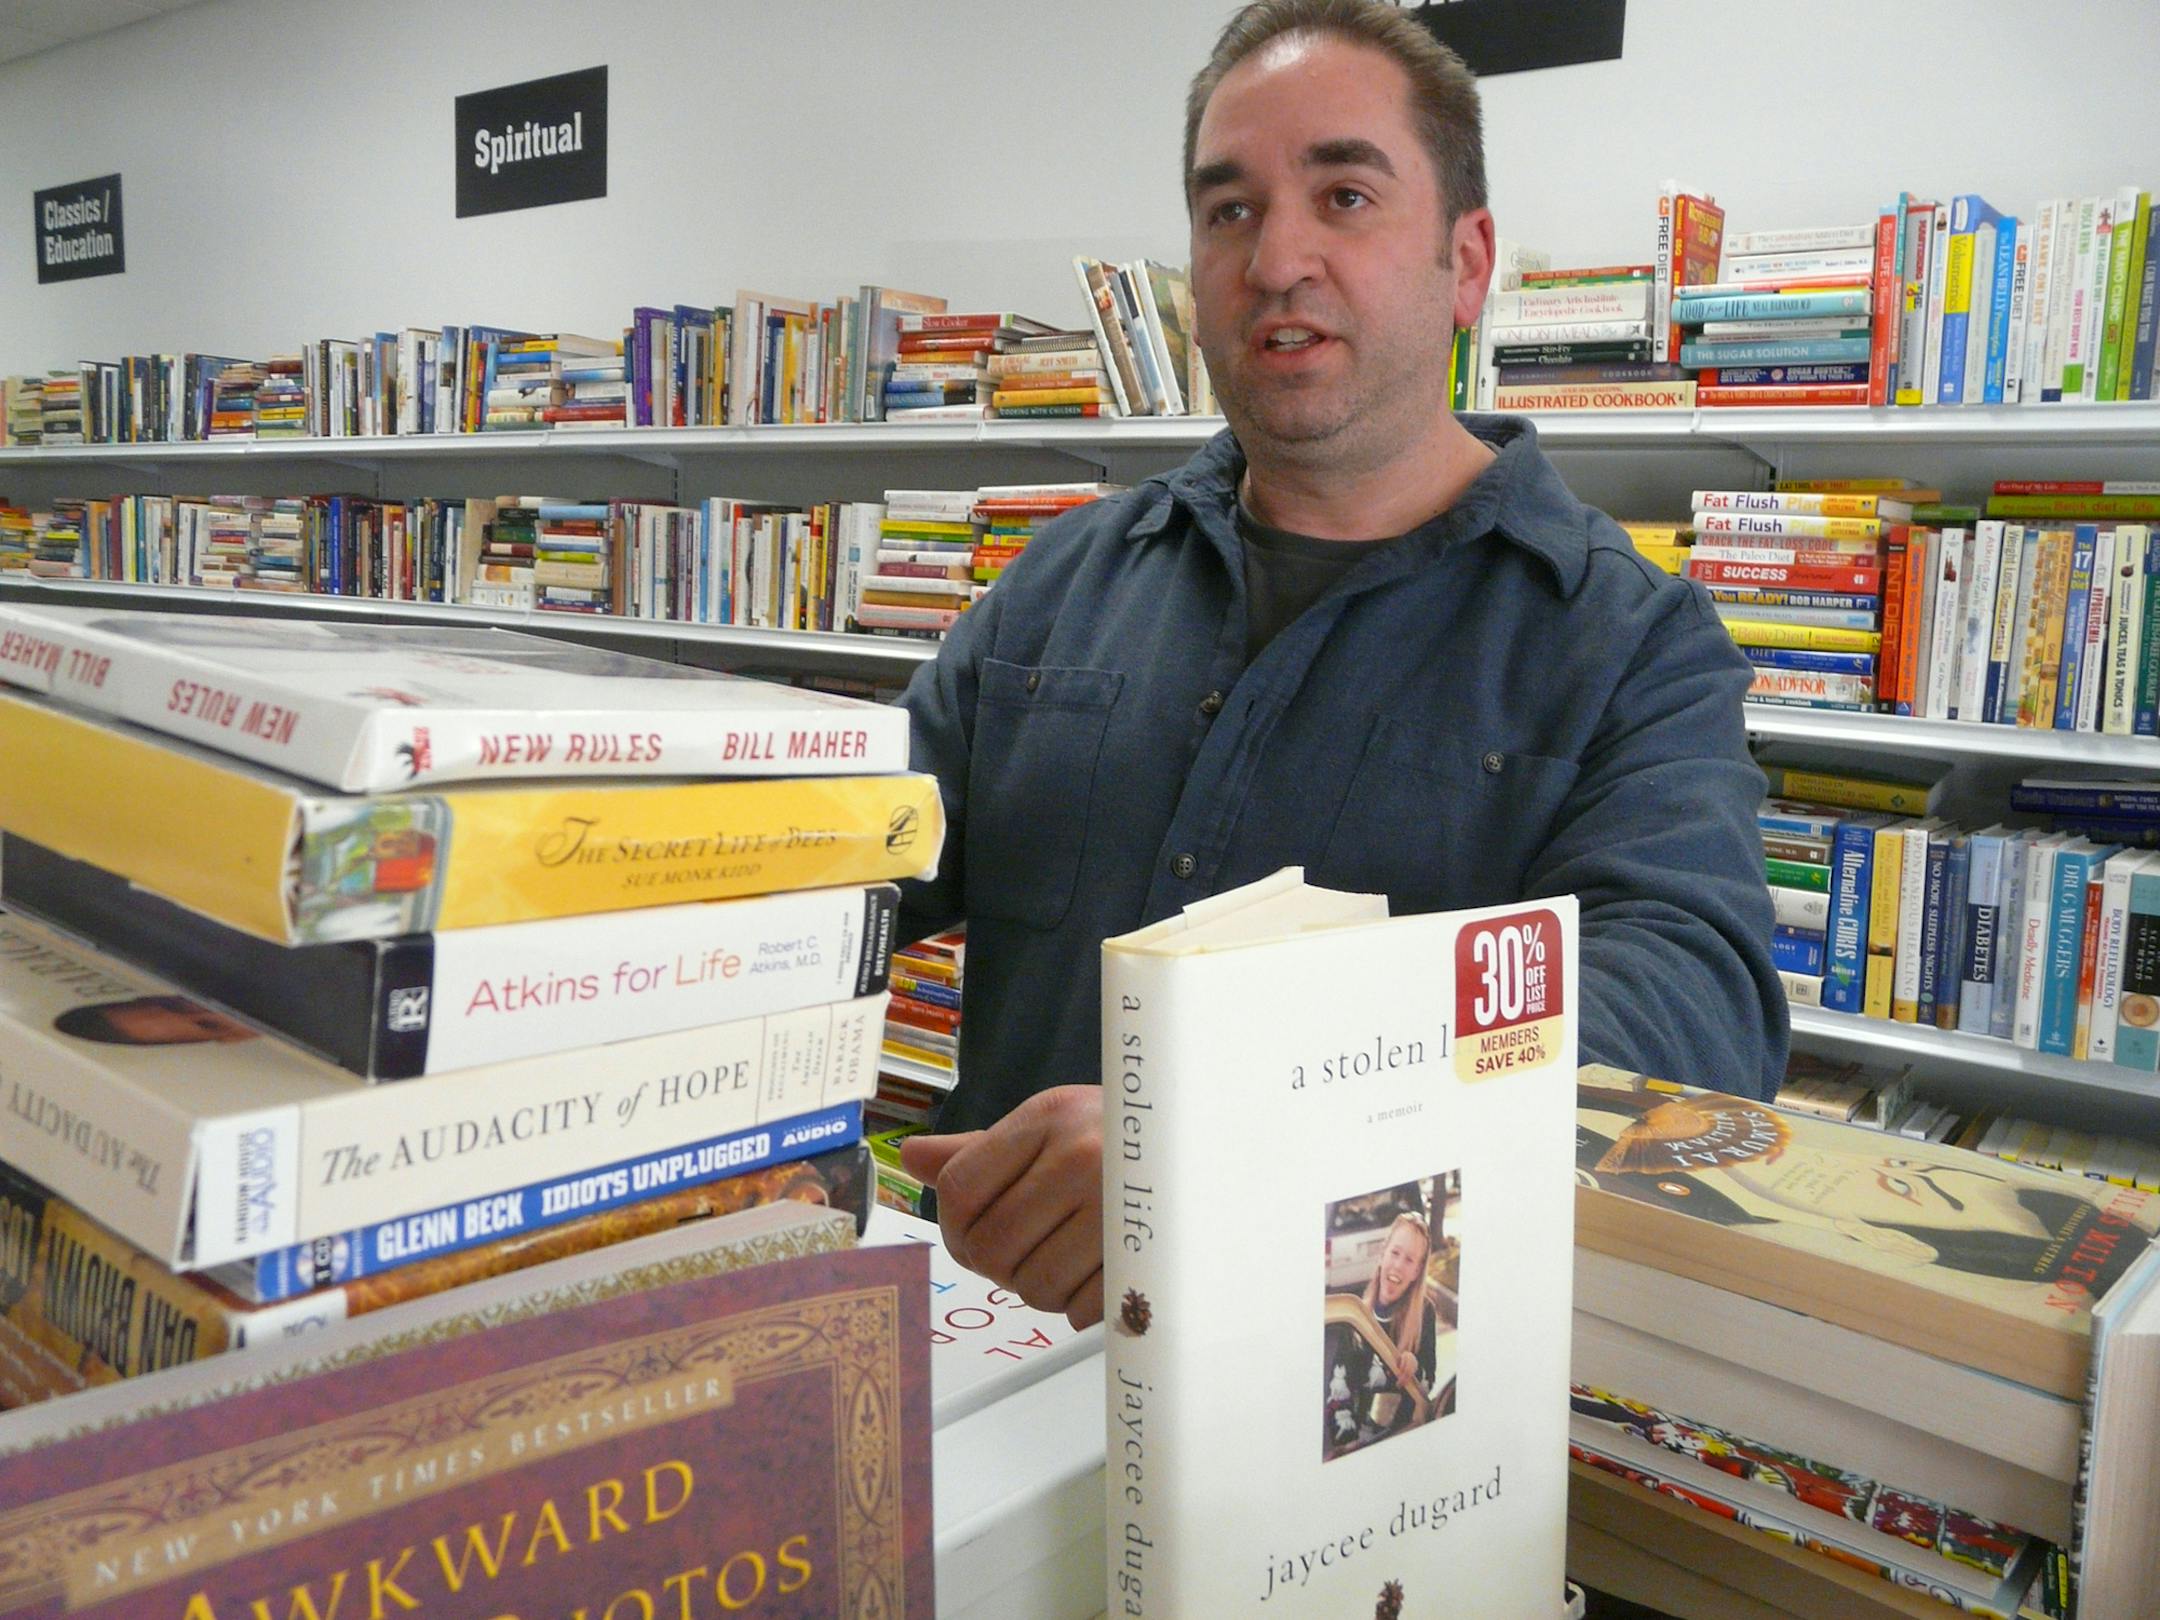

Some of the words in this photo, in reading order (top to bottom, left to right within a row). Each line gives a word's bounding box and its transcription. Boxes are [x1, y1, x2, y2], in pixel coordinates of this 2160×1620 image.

[474, 112, 582, 175] Spiritual
[44, 197, 101, 232] Classics
[2041, 207, 2052, 229] THE
[45, 230, 114, 266] Education
[1657, 216, 1670, 252] FREE
[2038, 234, 2049, 268] GAME
[2118, 229, 2129, 249] THE
[1657, 253, 1668, 283] DIET
[1881, 256, 1891, 277] LIFE
[1949, 235, 1968, 311] Volumetrics
[1998, 245, 2011, 277] LEAN
[2014, 262, 2027, 292] FREE
[2114, 250, 2126, 284] MAYO
[1679, 301, 1705, 320] FOOD
[1724, 300, 1749, 318] LIFE
[1914, 284, 1924, 309] THE
[1994, 278, 2008, 312] BELLY
[2012, 293, 2023, 321] DIET
[2033, 298, 2044, 326] DIET
[2109, 285, 2123, 322] CLINIC
[922, 318, 940, 328] Slow
[941, 317, 969, 328] Cooker
[1697, 349, 1715, 360] THE
[1717, 348, 1754, 360] SUGAR
[1756, 347, 1809, 359] SOLUTION
[1498, 395, 1588, 409] ILLUSTRATED
[1593, 392, 1678, 407] COOKBOOK
[1703, 493, 1729, 509] Fat
[1735, 493, 1780, 511] Flush
[1786, 496, 1823, 512] Plan
[1702, 535, 1733, 547] CRACK
[1737, 536, 1755, 548] THE
[1758, 537, 1804, 549] FAT-LOSS
[1808, 539, 1835, 551] CODE
[1705, 516, 1732, 531] Fat
[1738, 518, 1783, 534] Flush
[1789, 520, 1825, 535] Plan
[1719, 549, 1738, 560] The
[1740, 550, 1767, 562] Paleo
[1768, 552, 1790, 563] Diet
[1982, 534, 1996, 572] Atkins
[2002, 530, 2021, 567] Weight
[2074, 551, 2093, 569] 17
[1722, 565, 1788, 581] SUCCESS
[1887, 555, 1904, 597] TNT
[2001, 567, 2016, 590] Loss
[1715, 590, 1736, 603] You
[1737, 590, 1789, 605] READY!
[1790, 595, 1810, 606] BOB
[1812, 596, 1853, 608] HARPER
[2087, 587, 2105, 645] HYPOGLYCEMIA
[1738, 625, 1771, 643] Belly
[1882, 602, 1900, 649] DIET
[1994, 591, 2013, 656] Confidential
[2116, 615, 2130, 647] JUICES,
[2148, 601, 2160, 658] GLUTEN-FREE
[0, 629, 65, 675] MAHER
[69, 648, 112, 689] BILL
[2115, 648, 2128, 668] TEAS
[1777, 677, 1827, 695] ADVISOR
[2113, 677, 2126, 708] TONICS
[2145, 658, 2159, 705] GOURMET
[165, 678, 241, 728] RULES
[239, 701, 301, 747] NEW
[477, 733, 554, 767] NEW
[564, 733, 663, 765] RULES
[722, 730, 776, 762] BILL
[786, 729, 868, 760] MAHER
[614, 833, 711, 864] SECRET
[714, 830, 770, 858] LIFE
[785, 824, 839, 850] BEES
[620, 870, 661, 891] SUE
[660, 866, 711, 888] MONK
[712, 862, 763, 882] KIDD
[1840, 848, 1866, 917] Alternative
[1908, 834, 1924, 932] SPONTANEOUS
[1932, 861, 1944, 877] NO
[2061, 863, 2081, 906] DRUG
[1929, 878, 1944, 906] MORE
[1924, 906, 1940, 952] SLEEPLESS
[2026, 918, 2042, 955] Deadly
[2111, 908, 2123, 930] BODY
[2138, 926, 2148, 943] OF
[758, 937, 803, 957] Robert
[806, 935, 819, 951] C.
[874, 908, 891, 977] DIET/HEALTH
[1835, 917, 1860, 960] CURES
[1973, 904, 1993, 981] DIABETES
[2055, 907, 2077, 979] MUGGERS
[2144, 928, 2158, 981] SCIENCE
[749, 958, 792, 976] Atkins,
[795, 952, 823, 969] M.D.
[1473, 922, 1546, 1027] 30%
[1525, 965, 1547, 987] OFF
[1903, 933, 1919, 997] HEALING
[1922, 953, 1936, 991] NIGHTS
[2020, 954, 2038, 1000] Medicine
[2103, 932, 2122, 1010] REFLEXOLOGY
[2135, 948, 2146, 981] MIND
[465, 969, 601, 1019] Atkins
[612, 959, 668, 995] for
[674, 947, 743, 988] Life
[1525, 983, 1547, 1004] LIST
[1121, 994, 1143, 1013] a
[1526, 1001, 1546, 1016] PRICE
[832, 1017, 849, 1087] BARACK
[846, 1014, 866, 1085] OBAMA
[1481, 1025, 1541, 1054] MEMBERS
[1291, 1064, 1307, 1089] a
[1322, 1034, 1424, 1086] stolen
[1475, 1051, 1515, 1075] SAVE
[1518, 1045, 1547, 1067] 40%
[1121, 1032, 1154, 1163] stolen
[1366, 1114, 1374, 1125] a
[1377, 1102, 1424, 1122] memoir
[319, 1143, 382, 1188] The
[388, 1091, 603, 1170] AUDACITY
[617, 1082, 643, 1129] of
[657, 1058, 752, 1109] HOPE
[1663, 1110, 1737, 1153] WILLIAM
[1672, 1109, 1779, 1168] SAMURAI
[249, 1127, 278, 1210] AUDIO
[376, 1207, 459, 1264] GLENN
[463, 1189, 526, 1241] BECK
[541, 1167, 629, 1219] IDIOTS
[633, 1131, 773, 1193] UNPLUGGED
[780, 1117, 848, 1148] AUDIO
[1122, 1180, 1154, 1256] life
[314, 1235, 333, 1267] CD
[314, 1269, 332, 1282] 1
[2044, 1227, 2121, 1315] MILTON
[42, 1224, 137, 1379] BROWN
[137, 1286, 200, 1377] DAN
[1117, 1368, 1153, 1508] jaycee
[91, 1533, 198, 1590] NEW
[228, 1492, 340, 1545] YORK
[367, 1444, 487, 1503] TIMES
[510, 1374, 724, 1458] BESTSELLER
[1260, 1525, 1376, 1602] jaycee
[1388, 1465, 1504, 1538] dugard
[1120, 1521, 1153, 1620] duga
